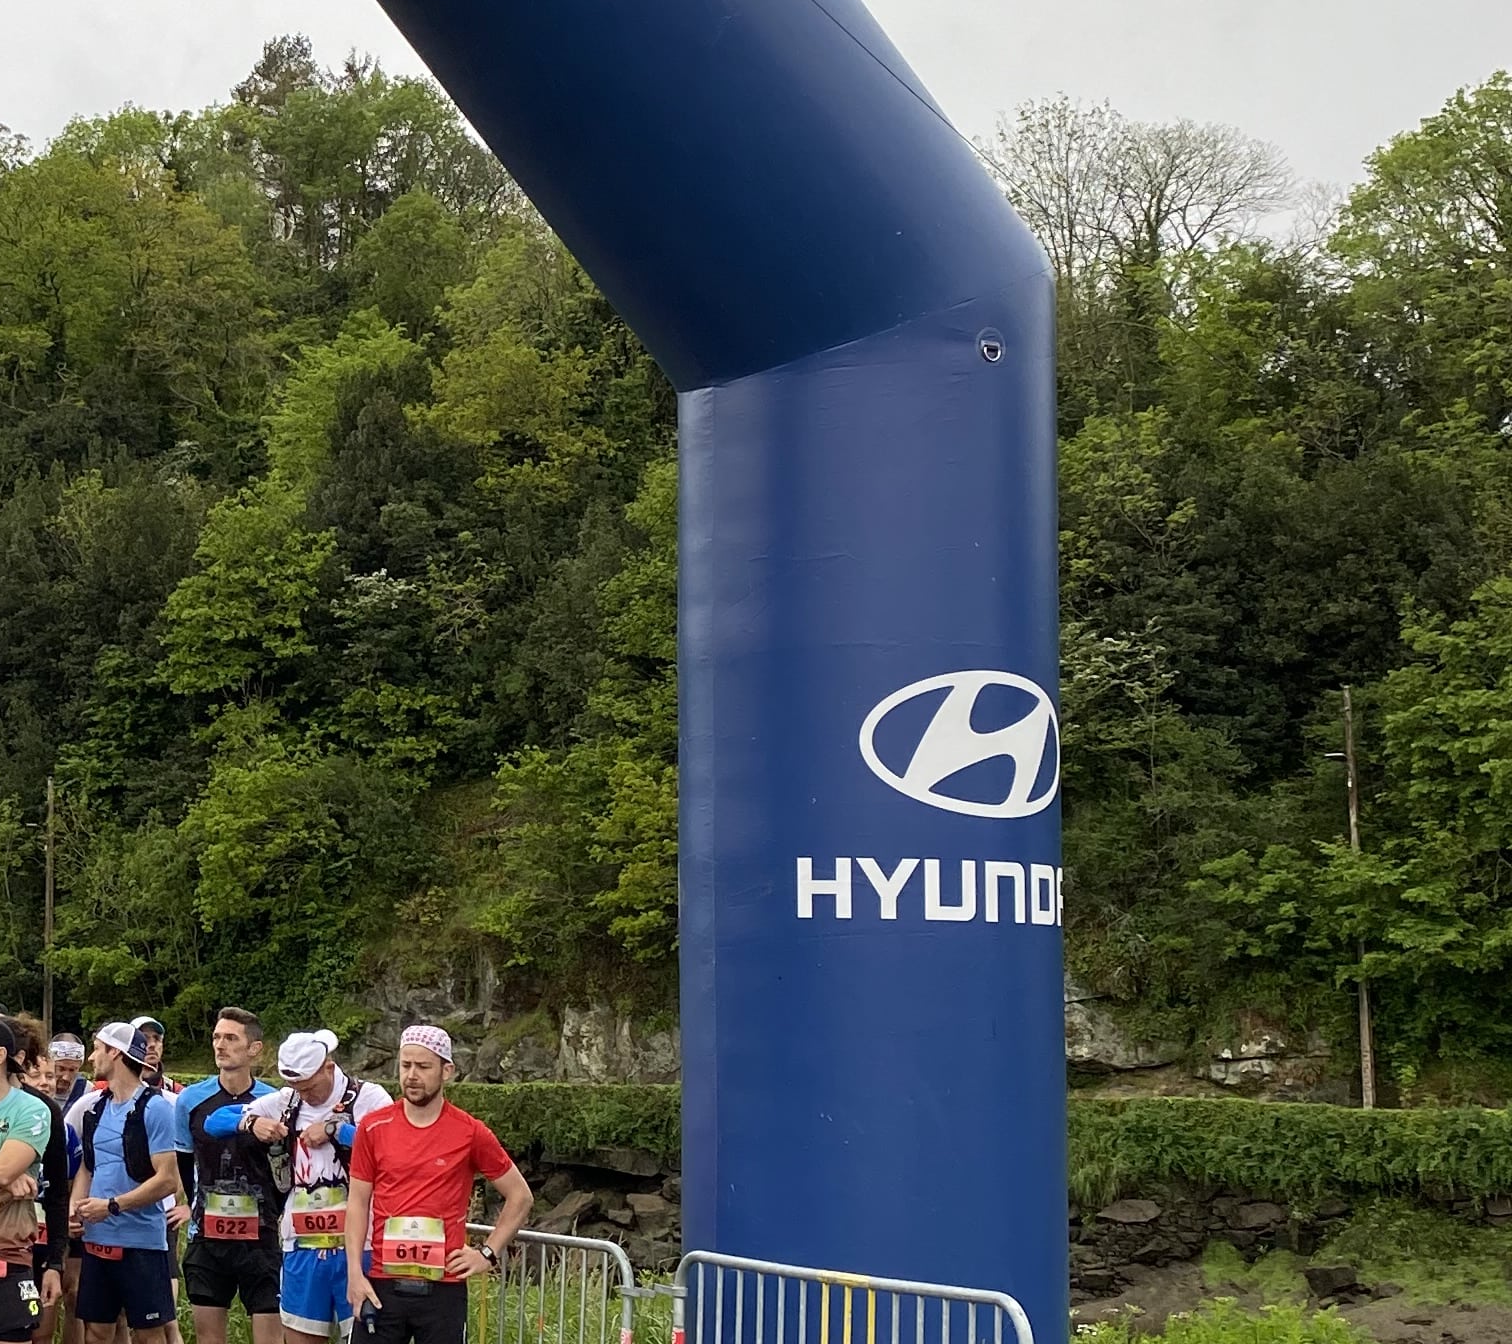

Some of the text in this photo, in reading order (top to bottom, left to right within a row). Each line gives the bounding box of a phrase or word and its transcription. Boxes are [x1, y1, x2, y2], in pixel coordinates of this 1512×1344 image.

[796, 856, 1063, 927] HYUND
[215, 1219, 247, 1235] 622
[304, 1214, 338, 1230] 602
[396, 1243, 433, 1261] 617
